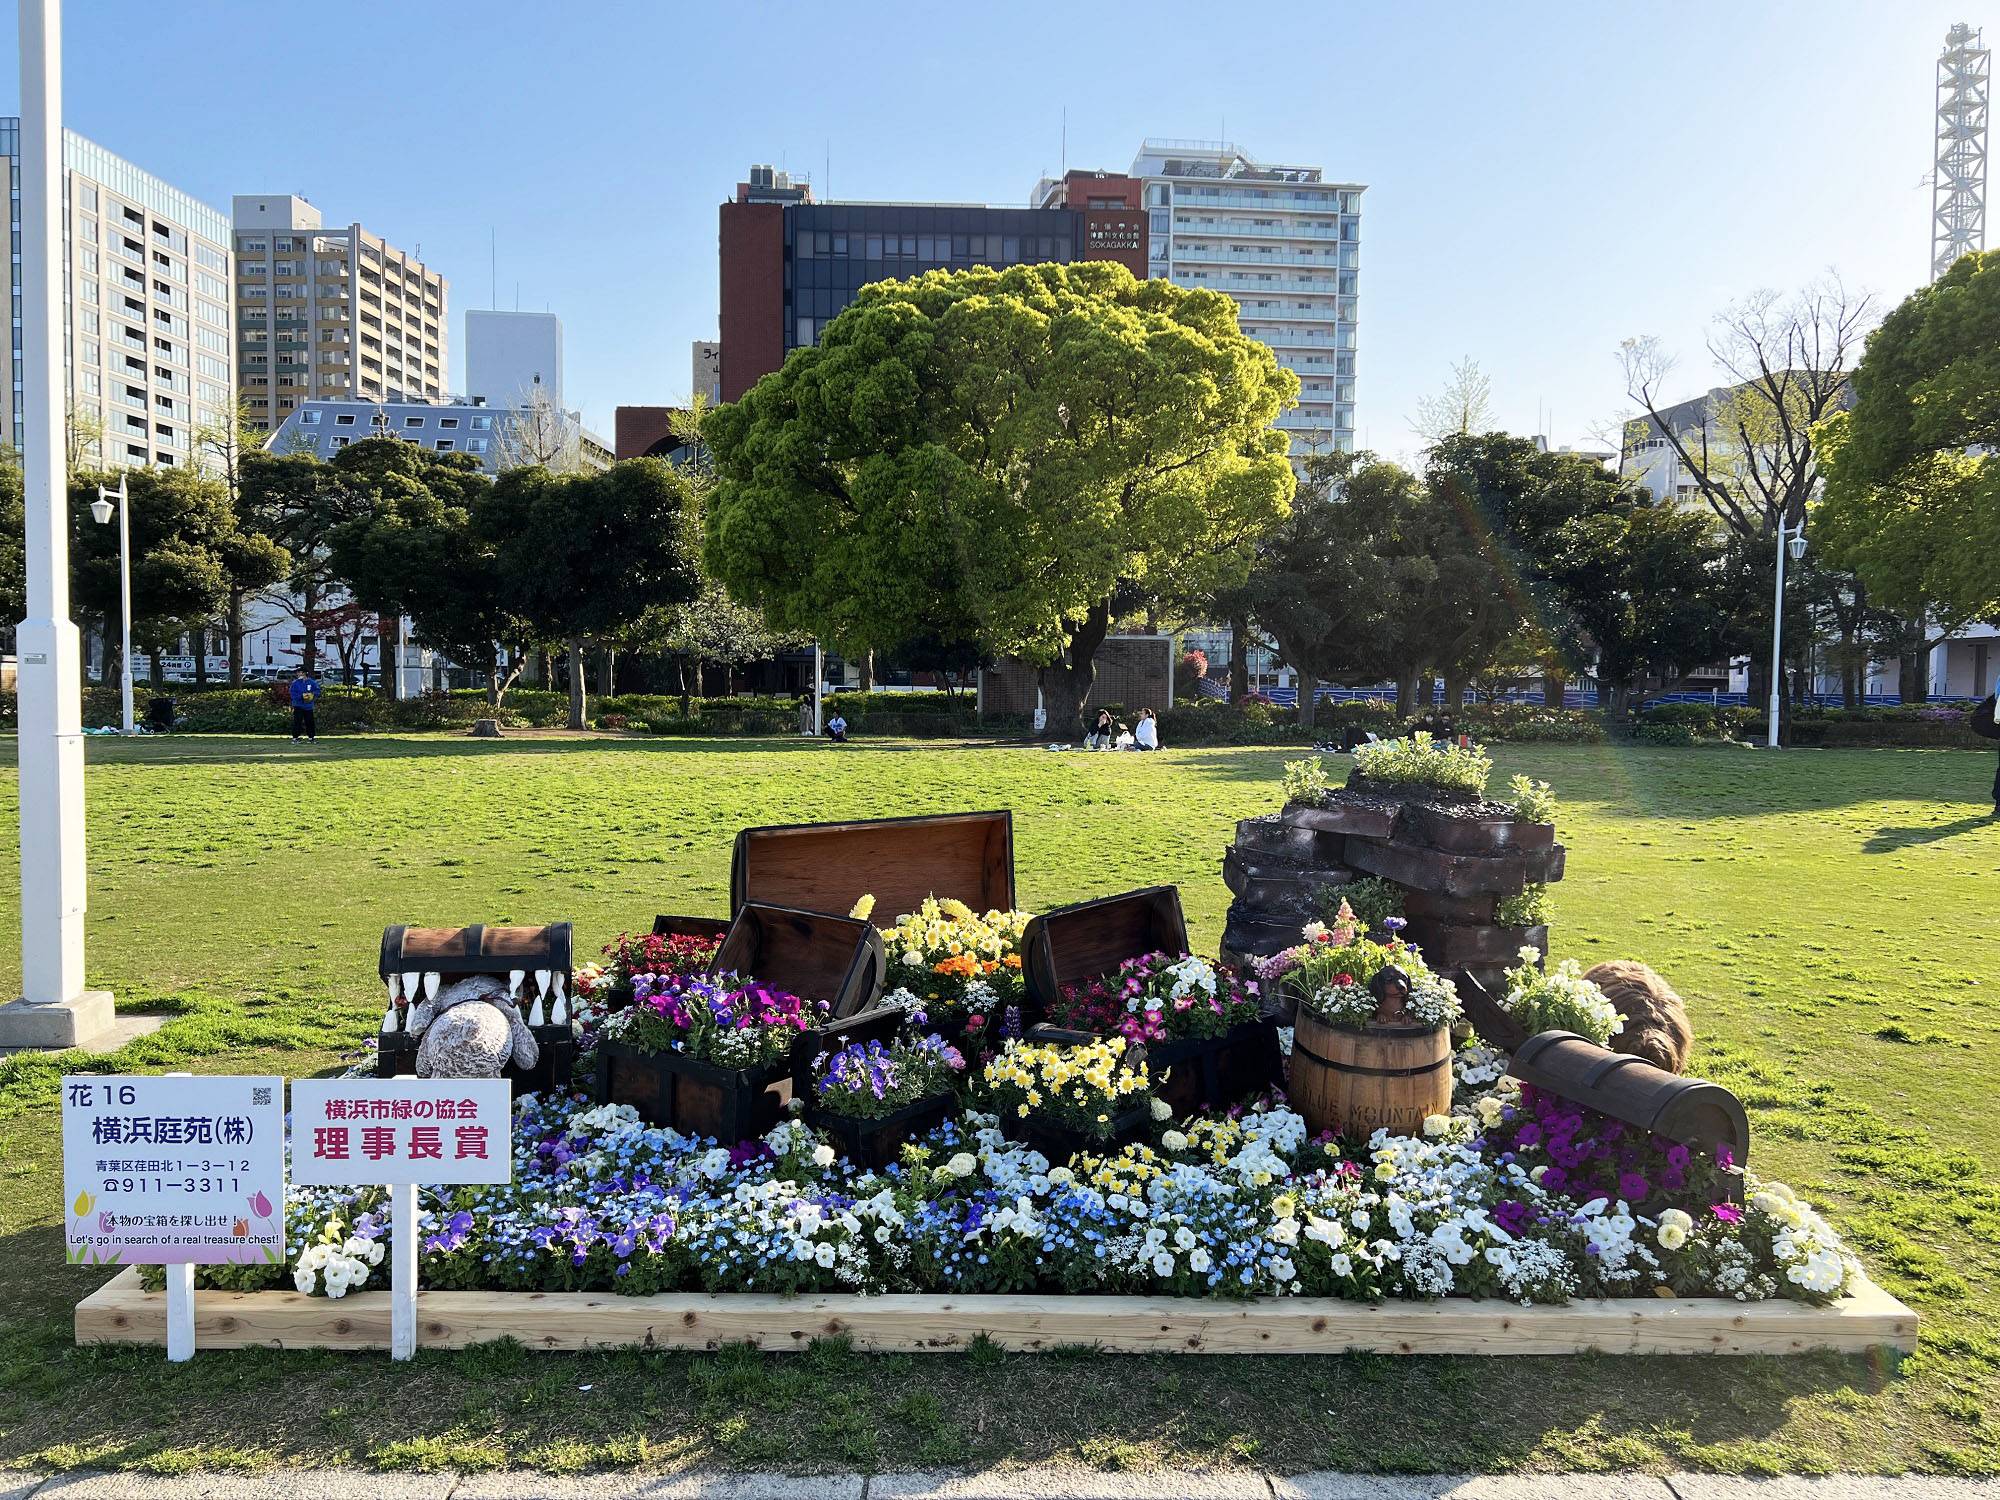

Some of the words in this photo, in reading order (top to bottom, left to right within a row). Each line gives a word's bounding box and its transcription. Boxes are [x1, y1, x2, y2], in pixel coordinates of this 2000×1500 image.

[1090, 241, 1139, 249] SOKAGAKKAI
[68, 1084, 93, 1107] 花
[102, 1085, 136, 1105] 16
[325, 1099, 478, 1120] 横浜市緑の協会
[1351, 1100, 1438, 1124] MOUNTAIN
[92, 1116, 254, 1145] 横浜庭苑(株)
[313, 1126, 489, 1161] 理事長賞
[70, 1235, 94, 1244] Let's
[97, 1237, 109, 1247] go
[112, 1235, 121, 1244] in
[124, 1235, 158, 1244] search
[161, 1235, 171, 1244] of
[182, 1235, 201, 1244] real
[204, 1235, 246, 1244] treasure
[248, 1235, 279, 1244] chest!
